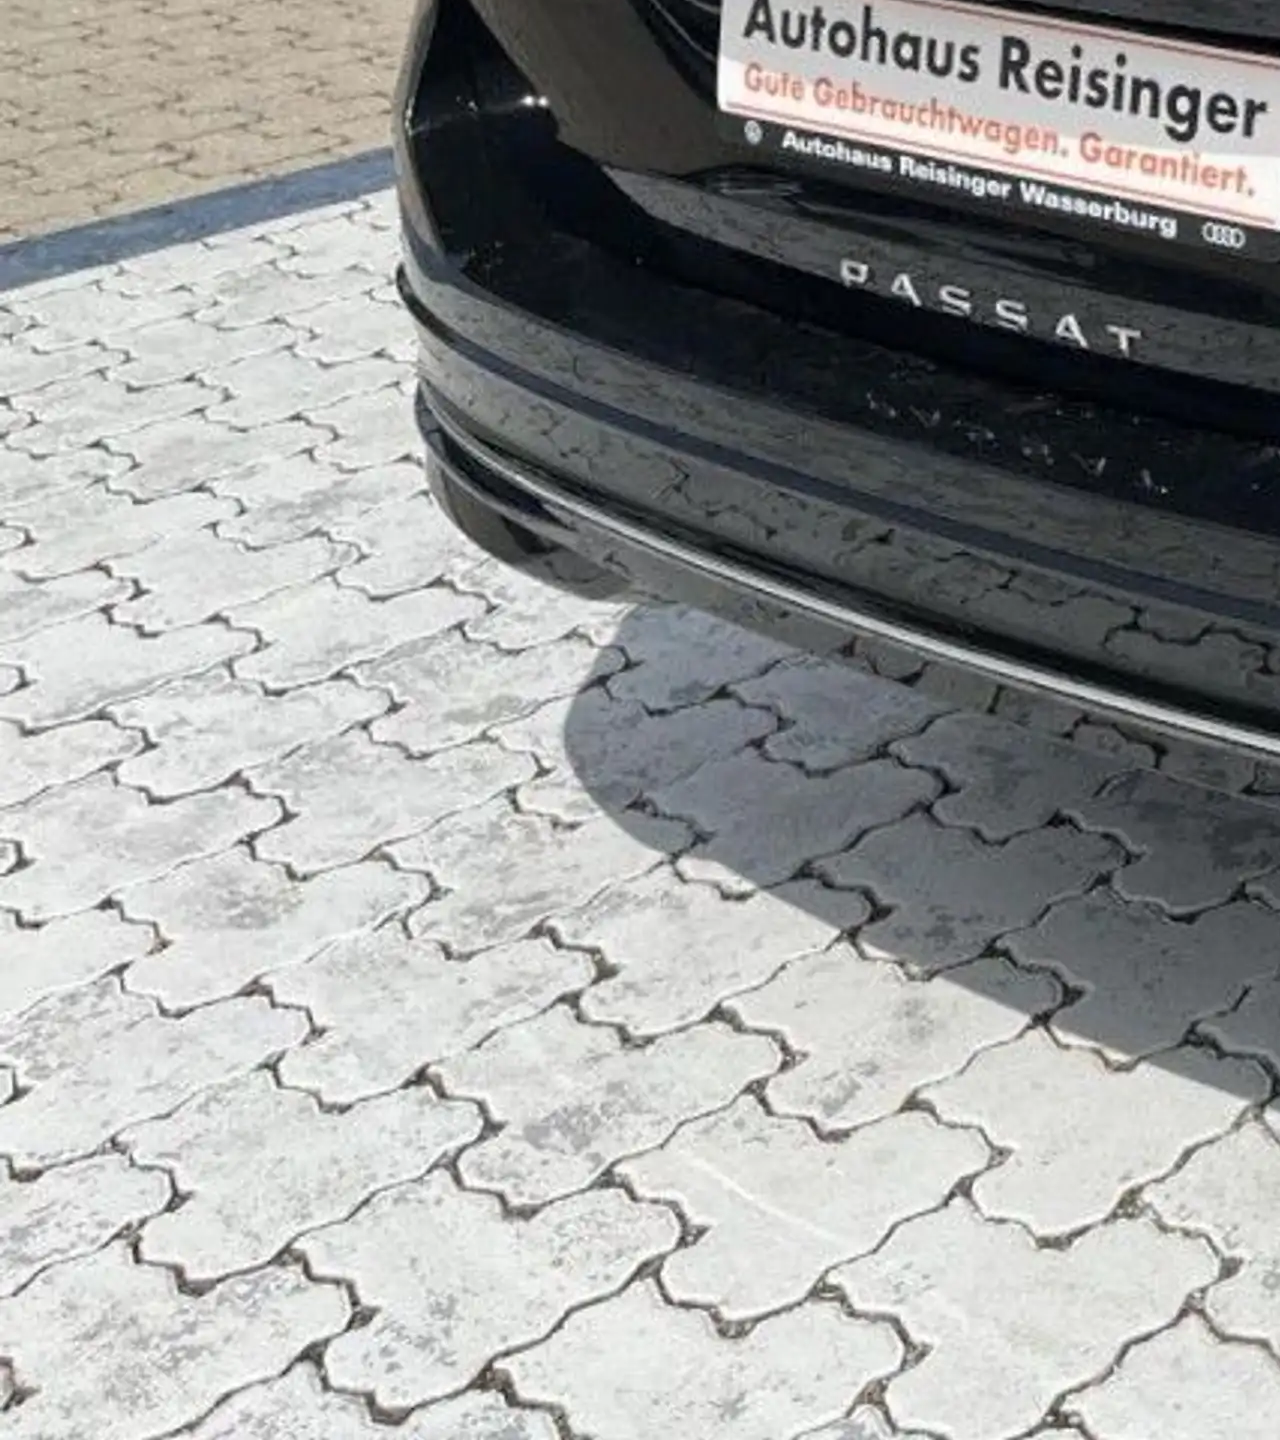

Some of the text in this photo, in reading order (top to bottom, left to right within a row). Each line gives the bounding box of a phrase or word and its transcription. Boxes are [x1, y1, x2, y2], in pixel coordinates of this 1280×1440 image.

[744, 62, 1256, 197] Gute Gebrauchtwagen. Garantiert.
[999, 35, 1268, 143] Reisinger
[781, 129, 1178, 239] Autohaus Reisinger Wasserburg
[839, 257, 1142, 359] PASSAT
